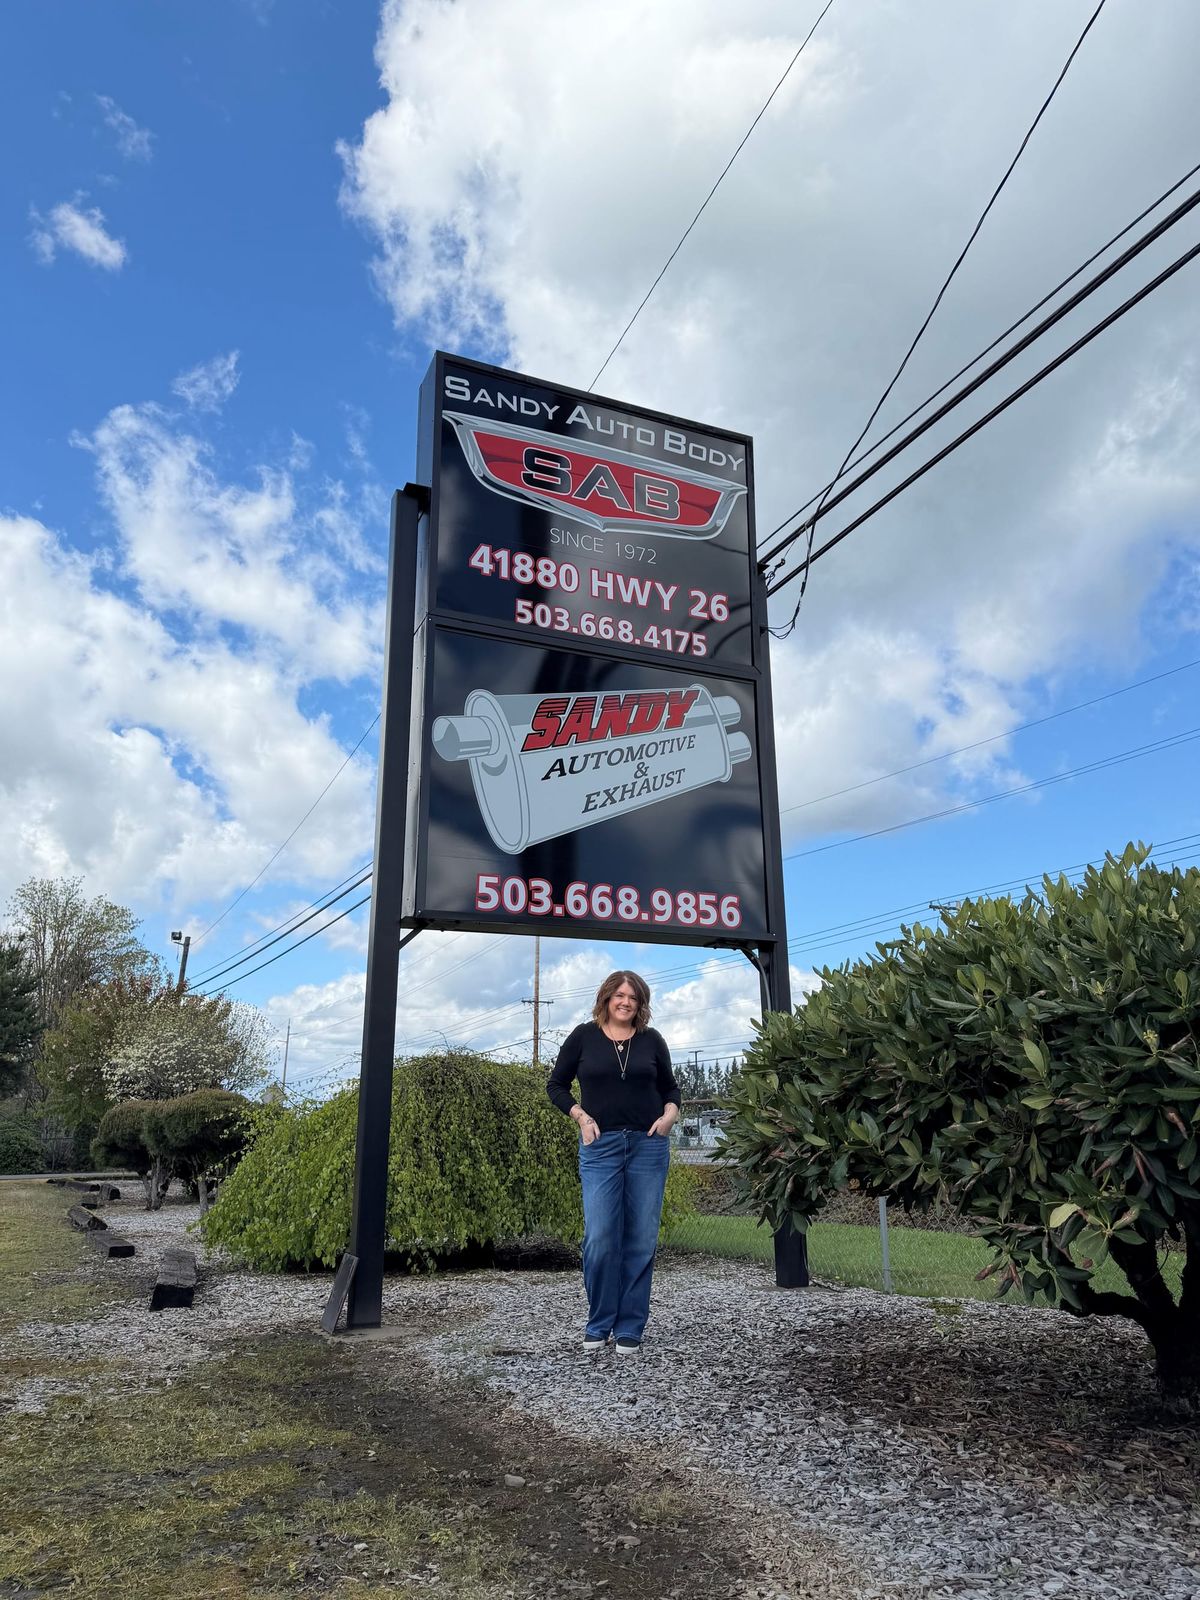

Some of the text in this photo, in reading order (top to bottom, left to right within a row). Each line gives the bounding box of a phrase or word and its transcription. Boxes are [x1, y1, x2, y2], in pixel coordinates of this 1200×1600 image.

[444, 375, 744, 472] SANDY AUTO BODY
[521, 447, 681, 521] SAB
[550, 527, 657, 565] SINCE 1972
[469, 543, 730, 622] 41880 HWY 26
[514, 599, 707, 657] 503.668.4175
[521, 689, 701, 752] SANDY
[541, 734, 696, 781] AUTOMOTIVE
[633, 762, 650, 779] &
[581, 768, 686, 814] EXHAUST
[475, 873, 742, 929] 503.668.9856
